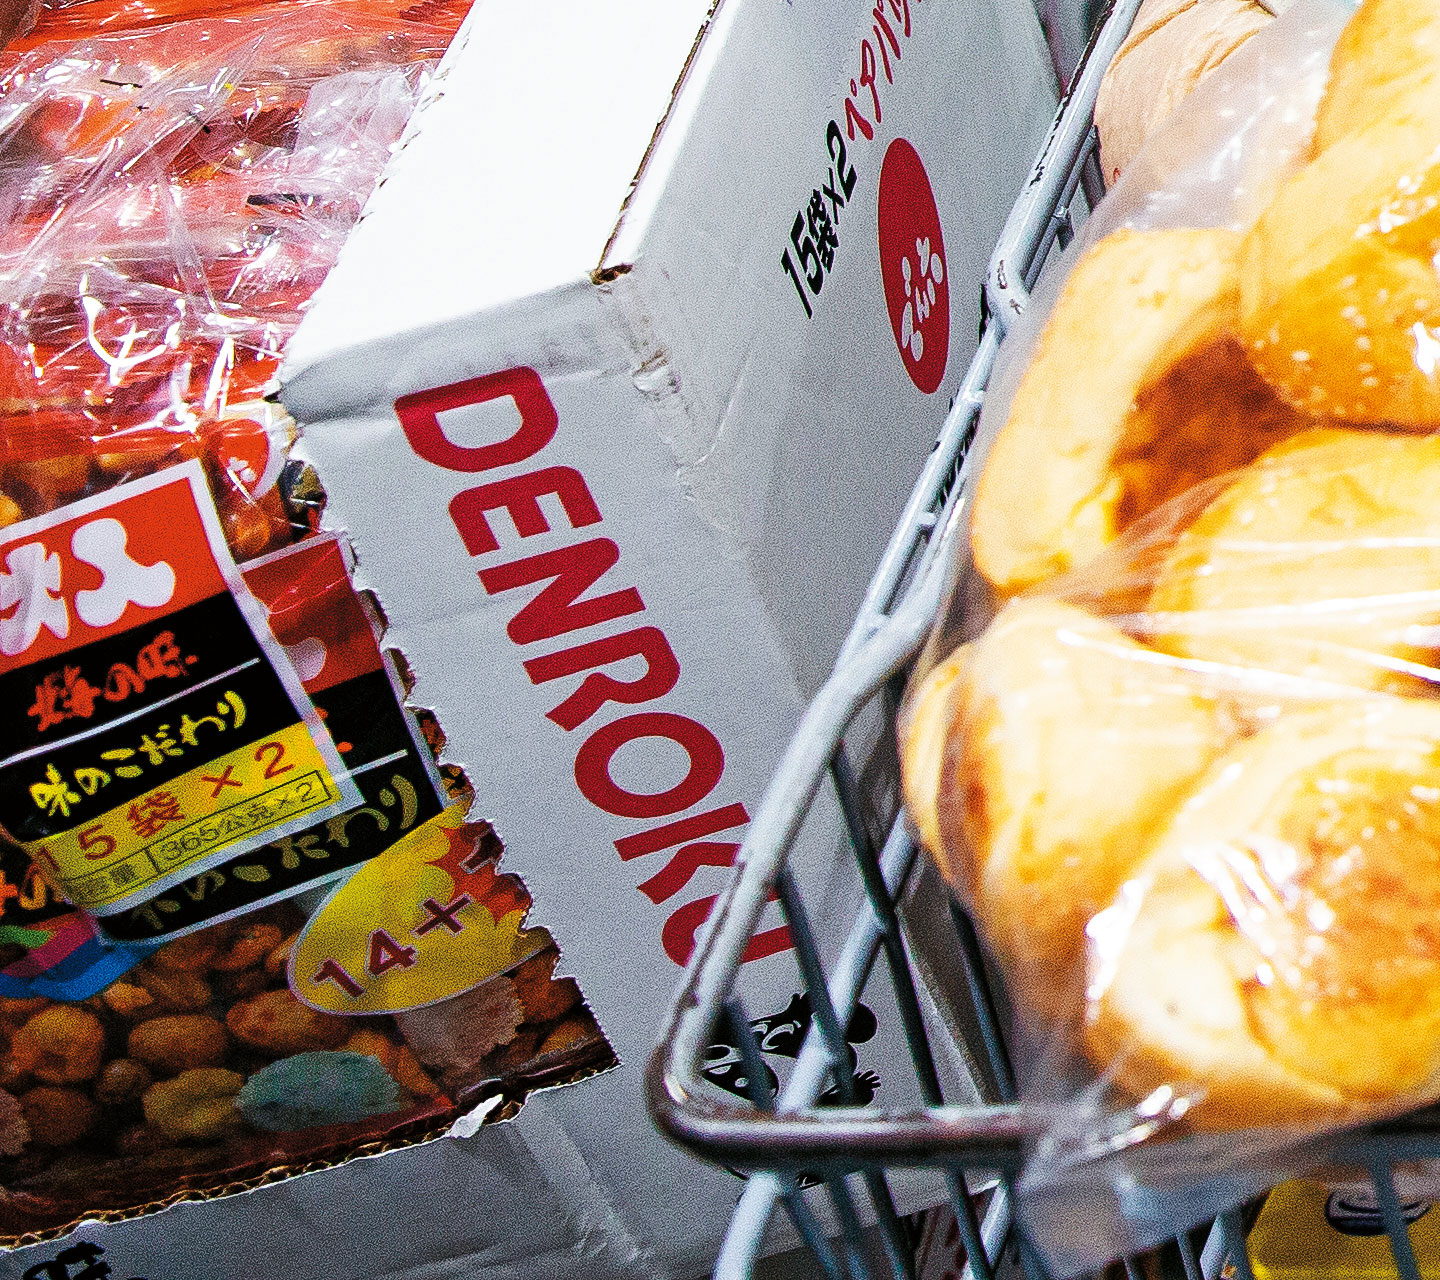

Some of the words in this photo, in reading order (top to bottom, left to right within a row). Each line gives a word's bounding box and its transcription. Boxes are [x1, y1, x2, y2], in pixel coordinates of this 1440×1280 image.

[30, 690, 247, 817] 味のこだわり
